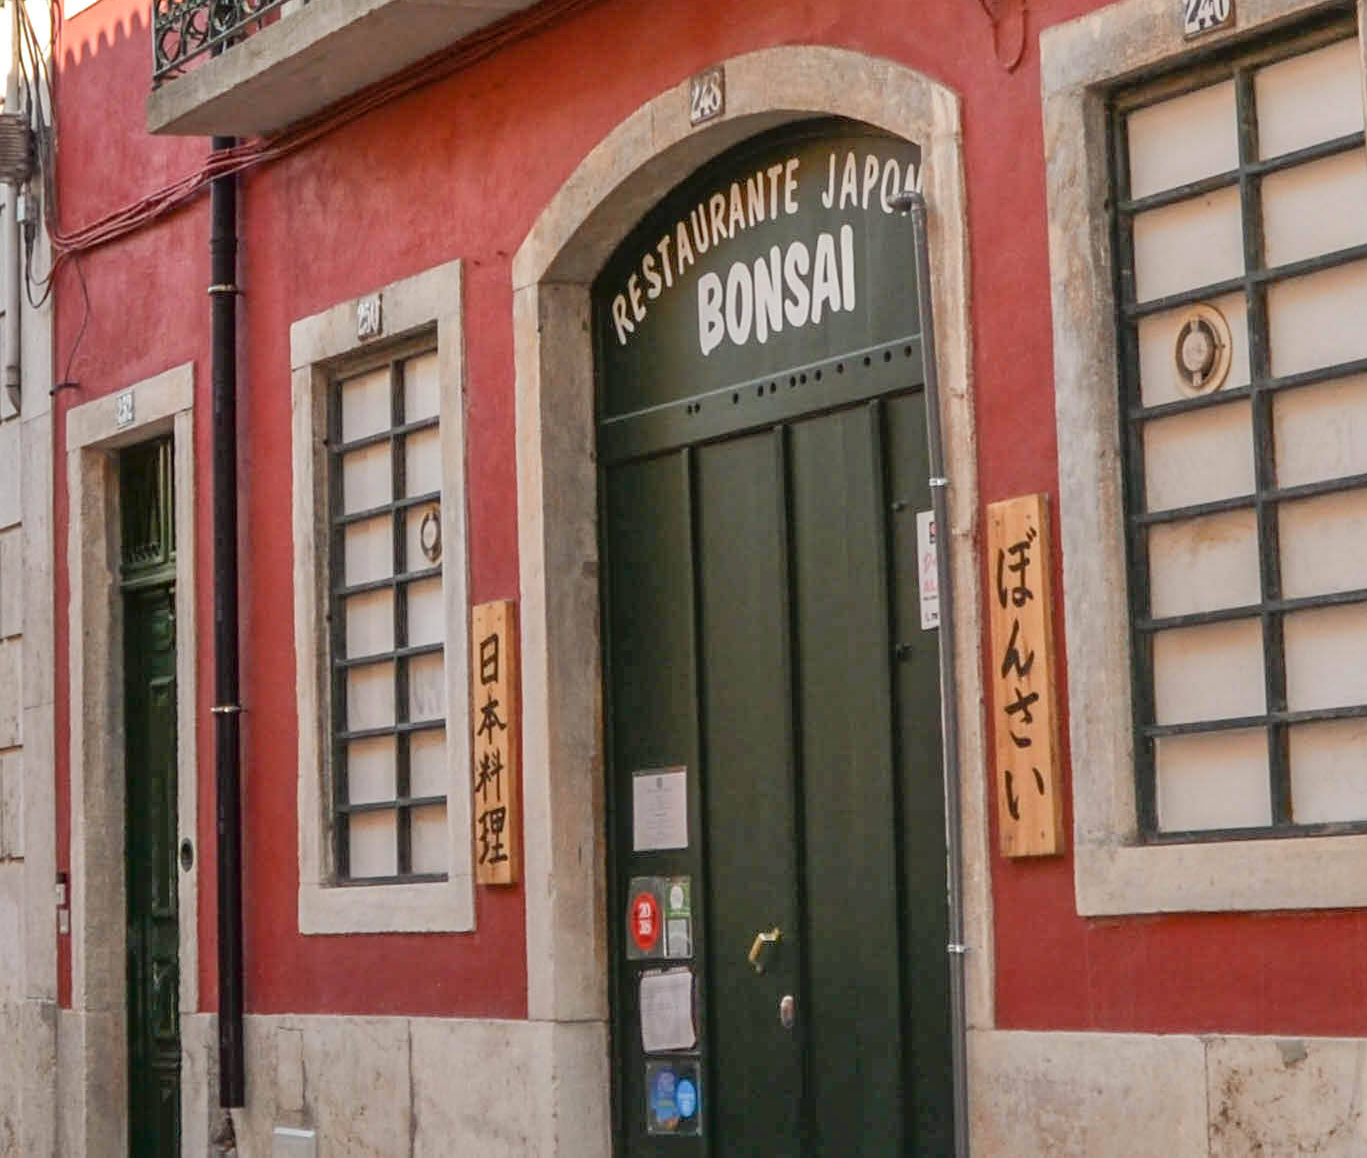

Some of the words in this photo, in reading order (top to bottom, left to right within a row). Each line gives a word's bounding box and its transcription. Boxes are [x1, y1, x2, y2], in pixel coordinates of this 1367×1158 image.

[691, 71, 721, 122] 248
[611, 157, 801, 345] RESTAURANTE
[697, 224, 856, 356] BONSAI
[474, 632, 509, 867] 日本料理
[996, 527, 1045, 821] ぼんさい
